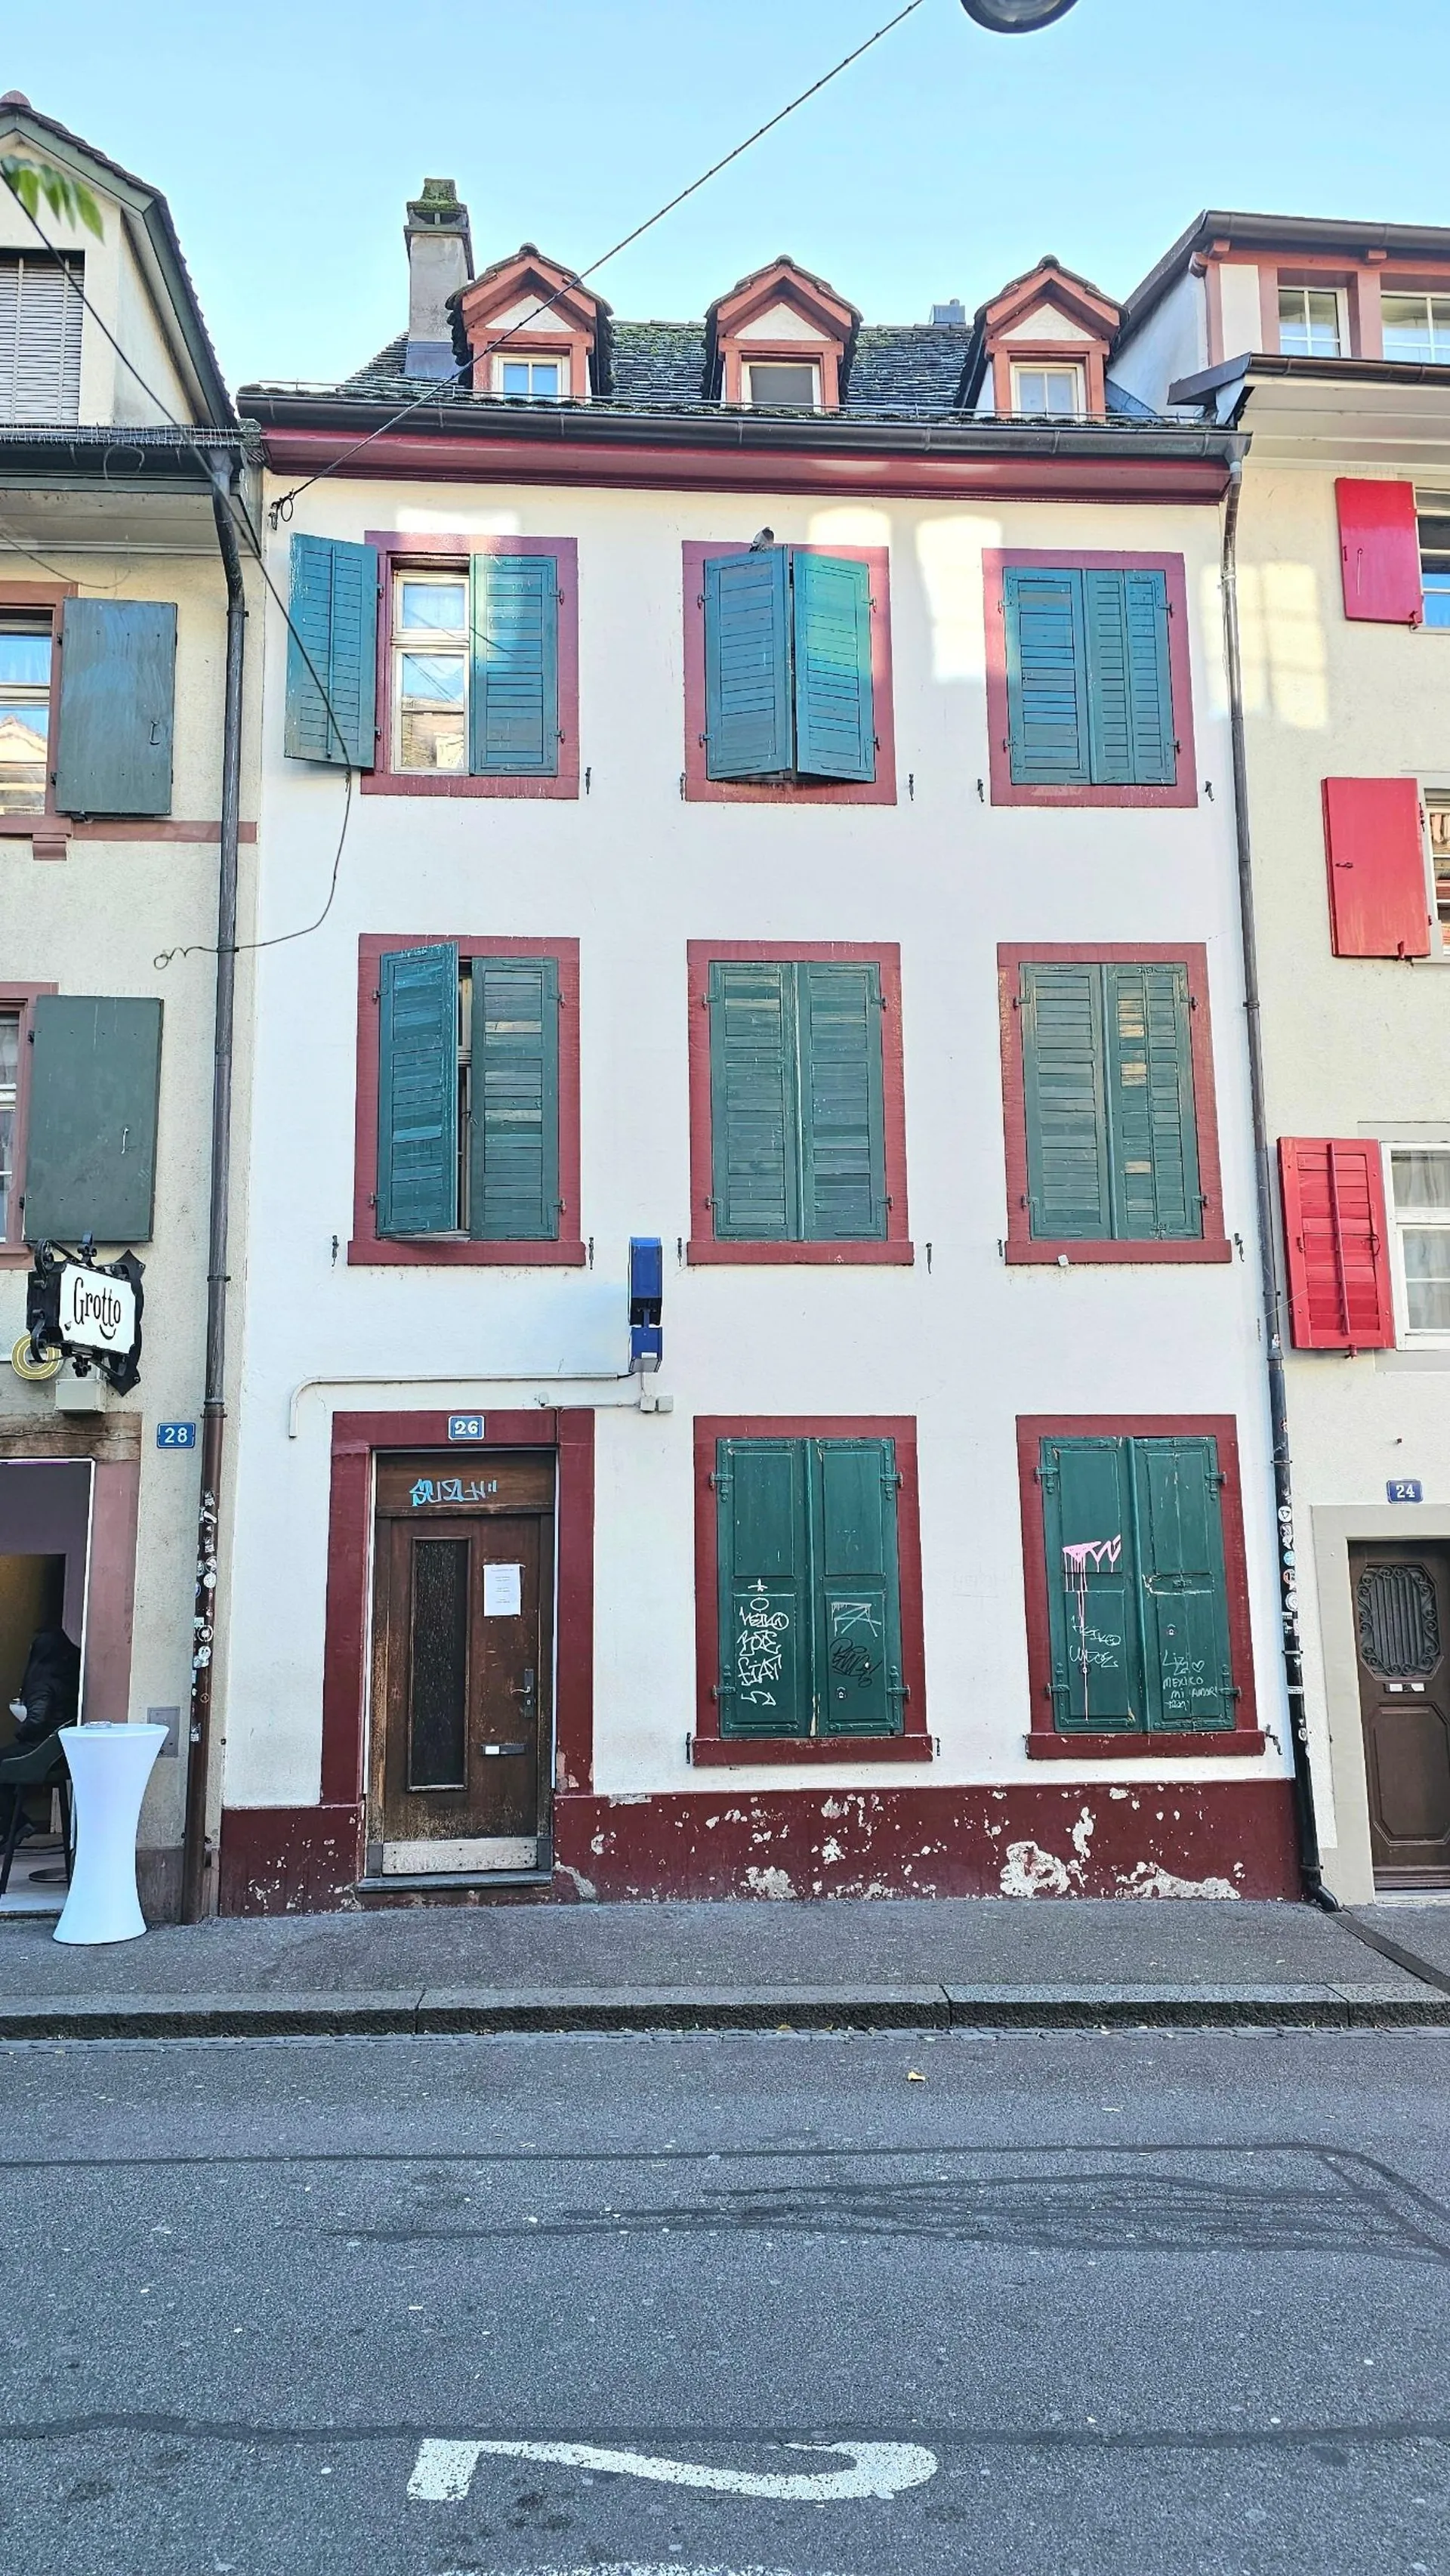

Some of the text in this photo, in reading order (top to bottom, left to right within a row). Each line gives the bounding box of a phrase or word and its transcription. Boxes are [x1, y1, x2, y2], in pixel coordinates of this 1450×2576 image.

[73, 1277, 122, 1327] Grotto
[164, 1427, 188, 1444] 28
[454, 1420, 480, 1435] 26
[1396, 1484, 1415, 1499] 24
